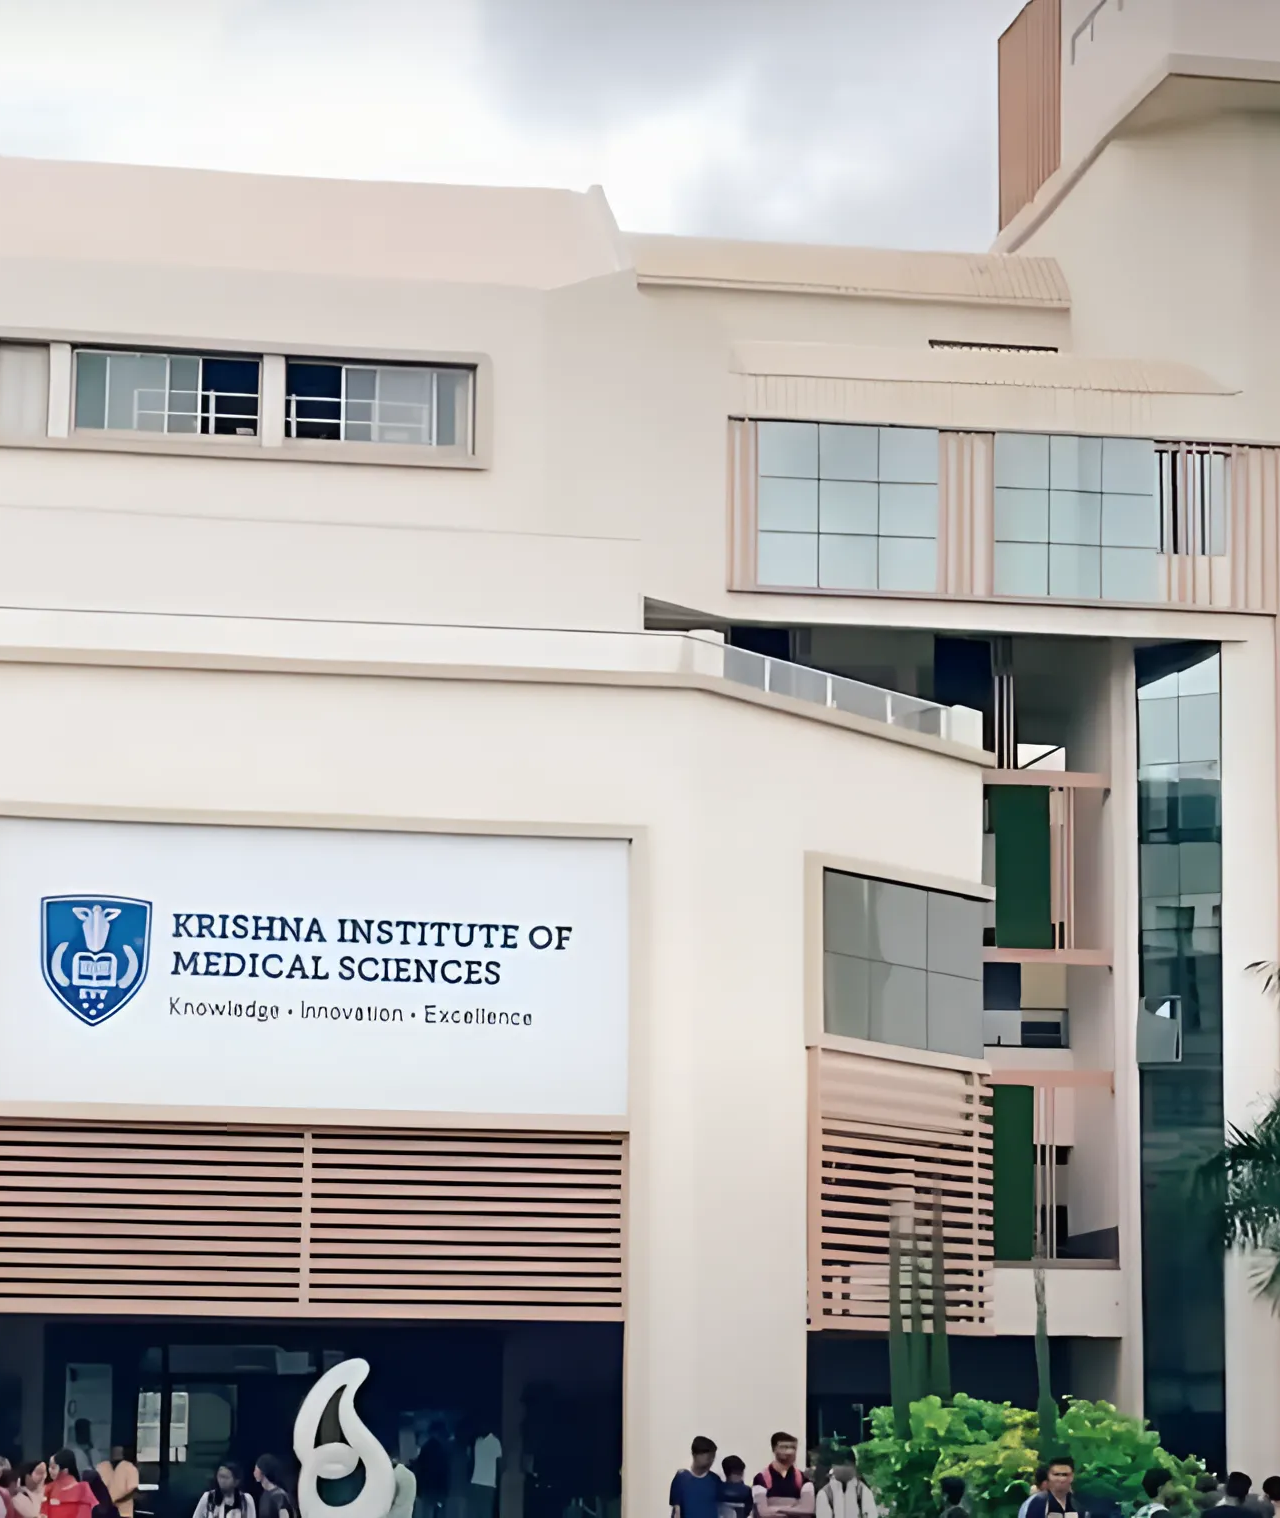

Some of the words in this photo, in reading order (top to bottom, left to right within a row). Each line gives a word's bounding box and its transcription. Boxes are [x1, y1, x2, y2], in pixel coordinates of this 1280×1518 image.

[171, 913, 328, 943] KRISHNA
[336, 918, 520, 950] INSTITUTE
[528, 925, 573, 951] OF
[170, 951, 330, 981] MEDICAL
[338, 955, 501, 986] SCIENCES
[169, 996, 279, 1023] Knowledge
[301, 1000, 404, 1022] Innovation
[424, 1004, 533, 1026] Excellence
